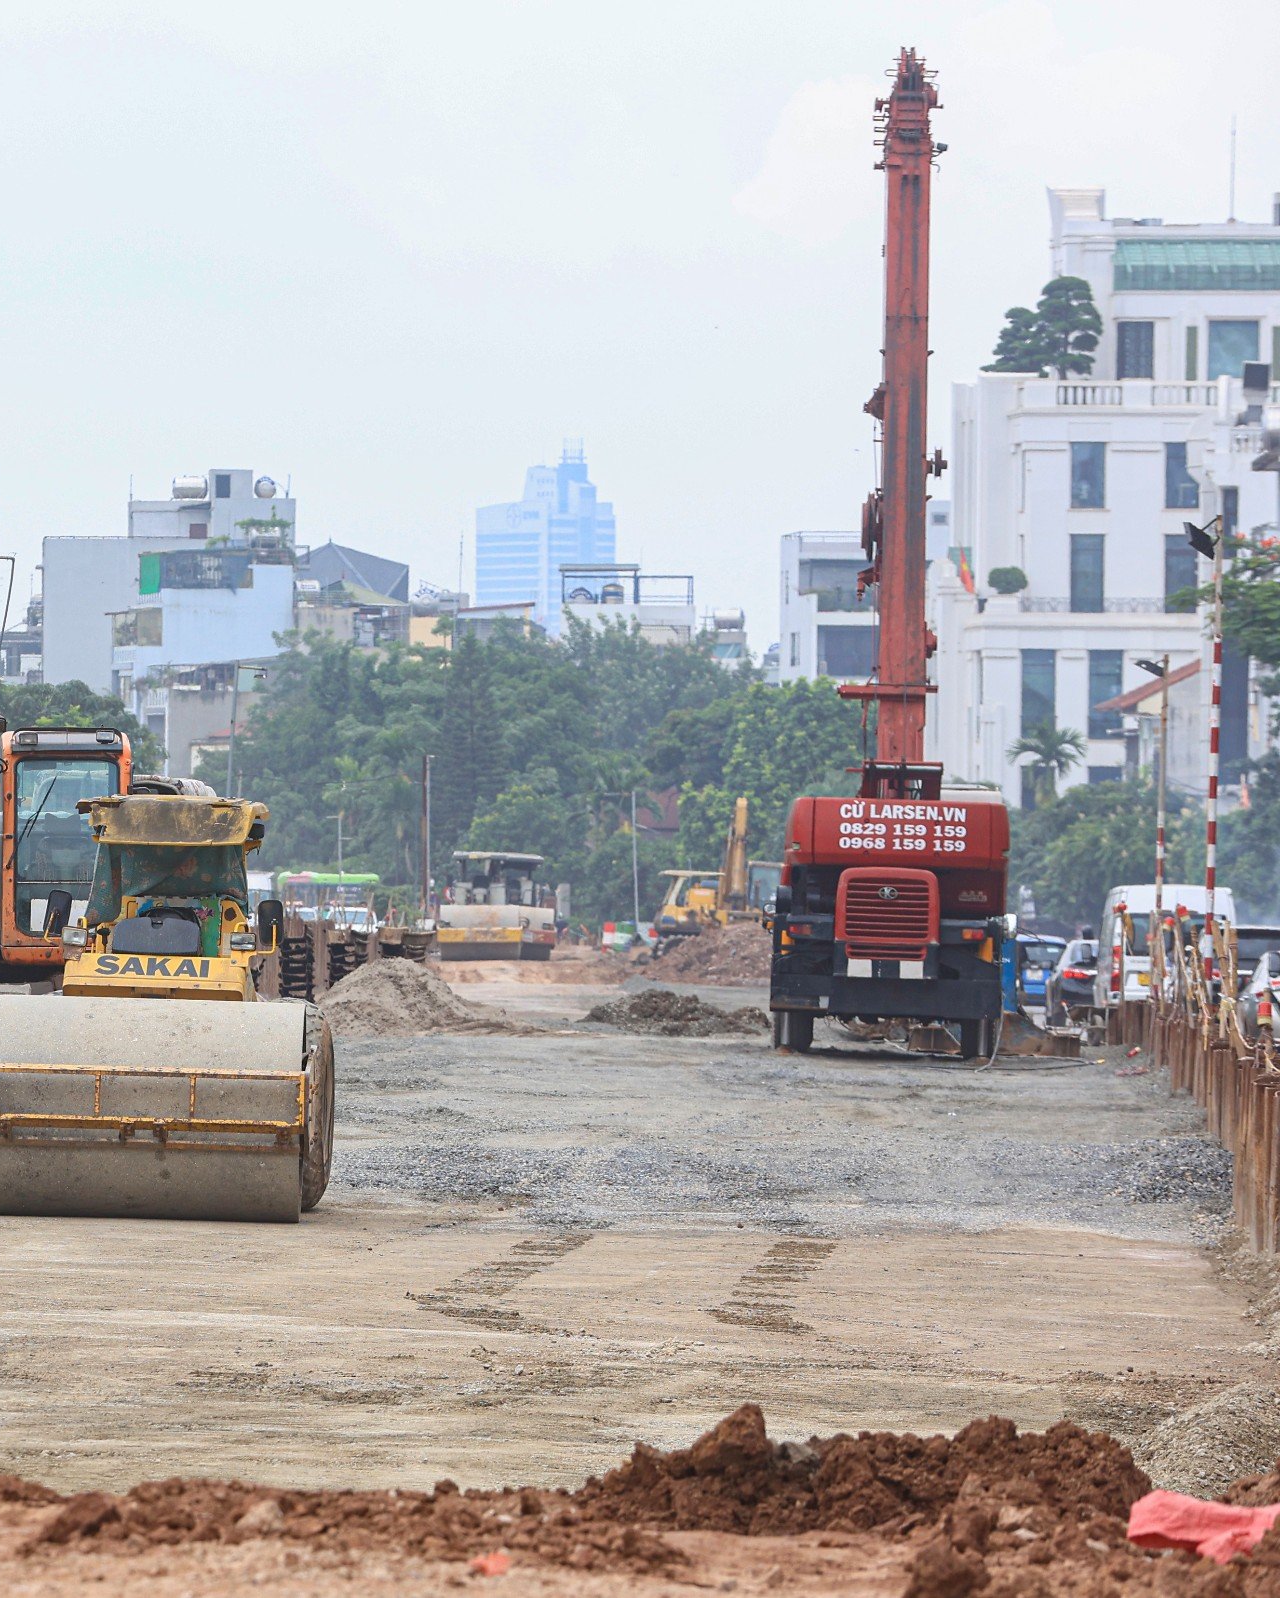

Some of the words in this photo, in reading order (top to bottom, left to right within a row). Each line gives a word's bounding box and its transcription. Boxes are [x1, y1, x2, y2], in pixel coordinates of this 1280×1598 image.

[840, 800, 866, 819] CỪ
[870, 804, 967, 822] LARSEN.VN
[839, 823, 887, 835] 0829
[893, 824, 928, 836] 159
[933, 825, 967, 837] 159
[839, 837, 886, 849] 0968
[892, 838, 926, 850] 159
[933, 839, 966, 852] 159
[94, 955, 210, 978] SAKAI
